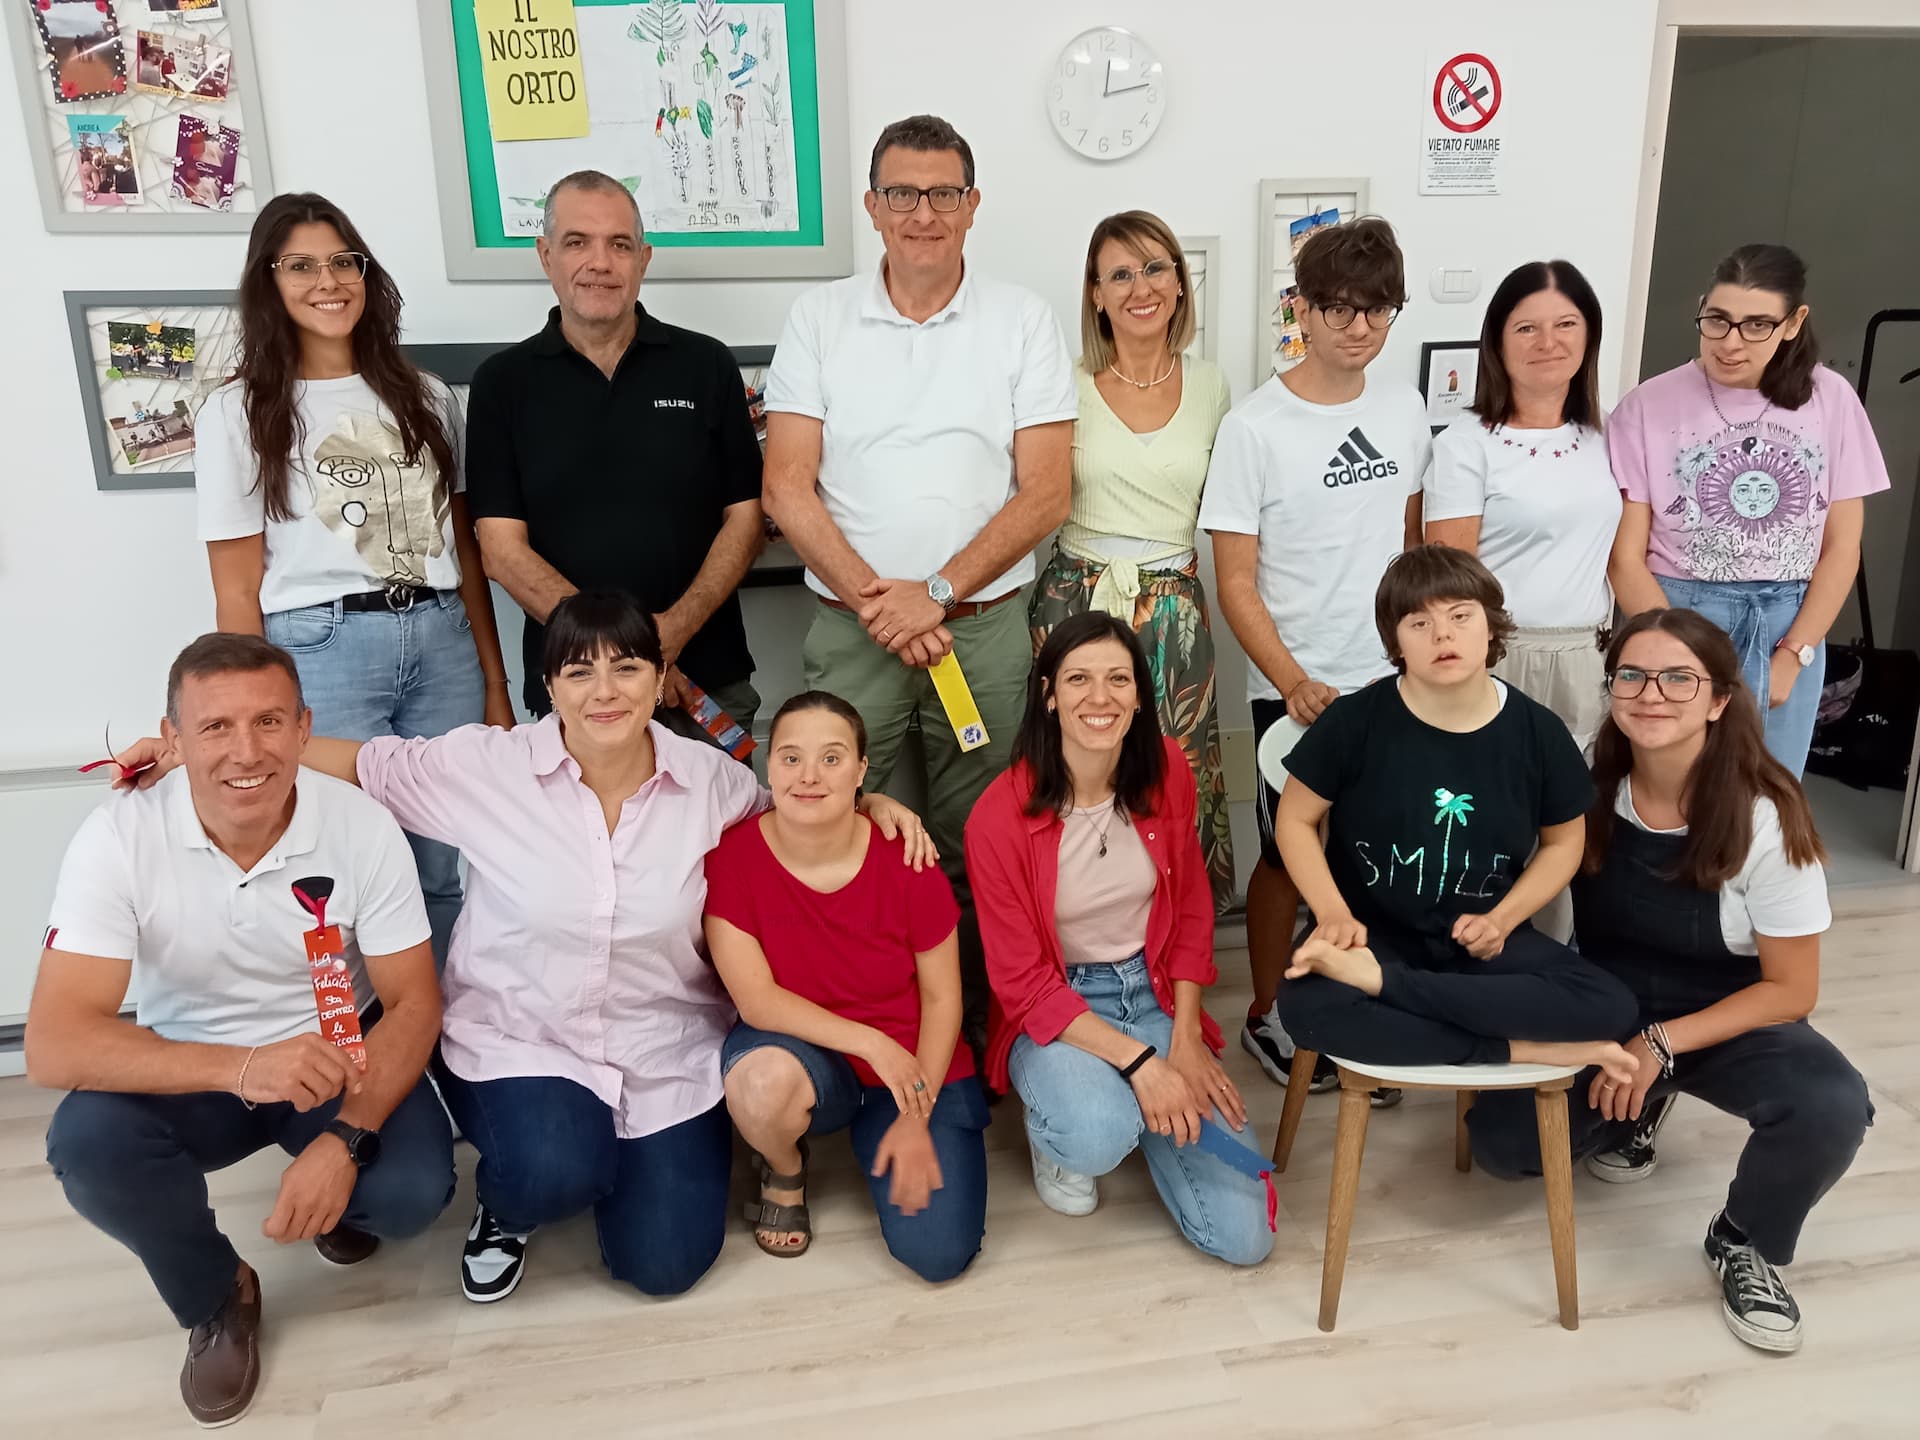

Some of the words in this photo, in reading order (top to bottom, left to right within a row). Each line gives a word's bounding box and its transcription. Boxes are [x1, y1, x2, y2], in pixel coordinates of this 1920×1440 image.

[514, 0, 538, 22] IL
[488, 28, 576, 61] NOSTRO
[1099, 35, 1115, 52] 12
[1060, 61, 1076, 78] 10
[1141, 62, 1152, 79] 2
[507, 71, 576, 105] ORTO
[1146, 87, 1158, 104] 3
[1059, 110, 1070, 127] 8
[1139, 112, 1150, 128] 4
[1077, 128, 1088, 146] 7
[1098, 137, 1109, 153] 6
[1121, 129, 1133, 146] 5
[1428, 138, 1462, 151] VIETATO
[1464, 138, 1500, 151] FUMARE
[654, 399, 695, 409] ISUZU
[1323, 460, 1399, 488] adidas
[1355, 830, 1511, 904] SMILE
[313, 951, 331, 967] La
[321, 1004, 354, 1020] DENTRO
